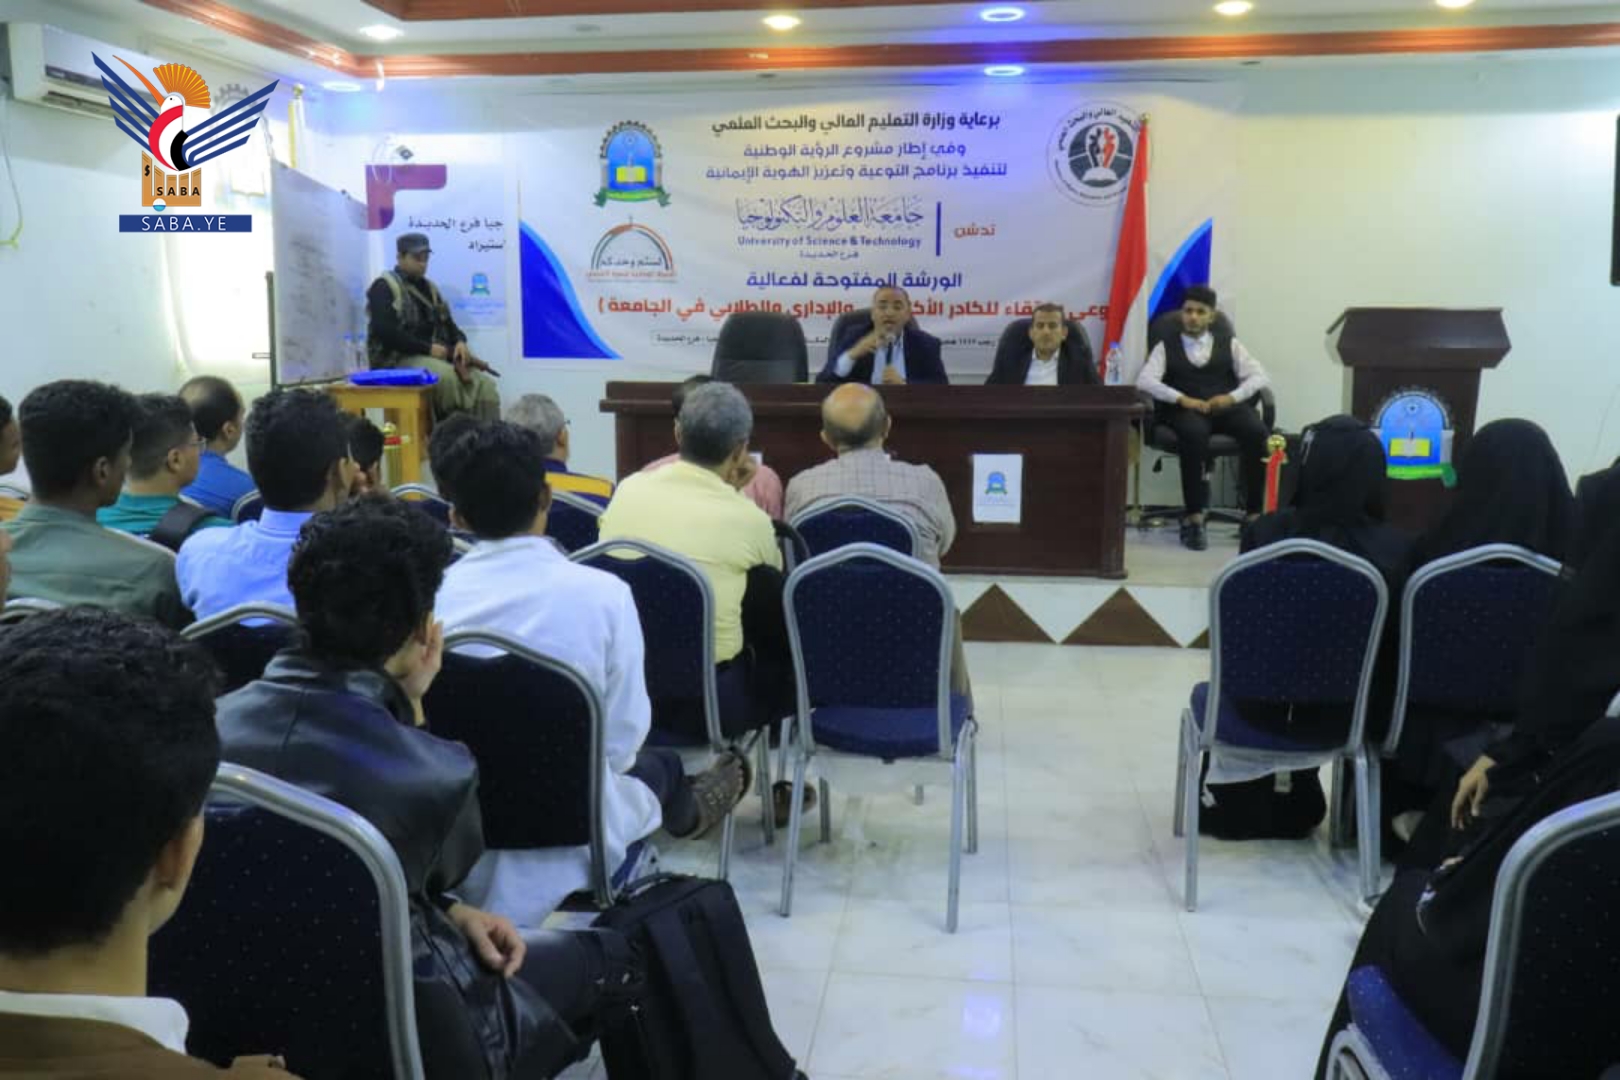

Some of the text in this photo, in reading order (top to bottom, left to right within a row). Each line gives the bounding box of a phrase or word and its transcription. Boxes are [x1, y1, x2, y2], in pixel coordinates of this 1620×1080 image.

[711, 111, 1001, 137] برعاية وزارة التعليم العالي والبحث العلمي
[743, 144, 796, 159] الوطنية
[799, 142, 839, 158] الرؤية
[842, 141, 894, 158] مشروع
[897, 142, 926, 159] إطار
[705, 162, 1008, 183] لتنفيذ برنامج التوعية وتعزيز الهوية الإيمانية
[736, 194, 924, 231] جامعة العلوم والتكنولوجيا
[408, 215, 456, 231] الحديدة
[459, 217, 480, 233] فرع
[737, 235, 922, 249] University of Science & Technology
[746, 270, 962, 291] الورشة المفتوحة لفعالية
[607, 297, 672, 318] الجامعة
[676, 297, 706, 322] في
[949, 300, 999, 319] للكادر
